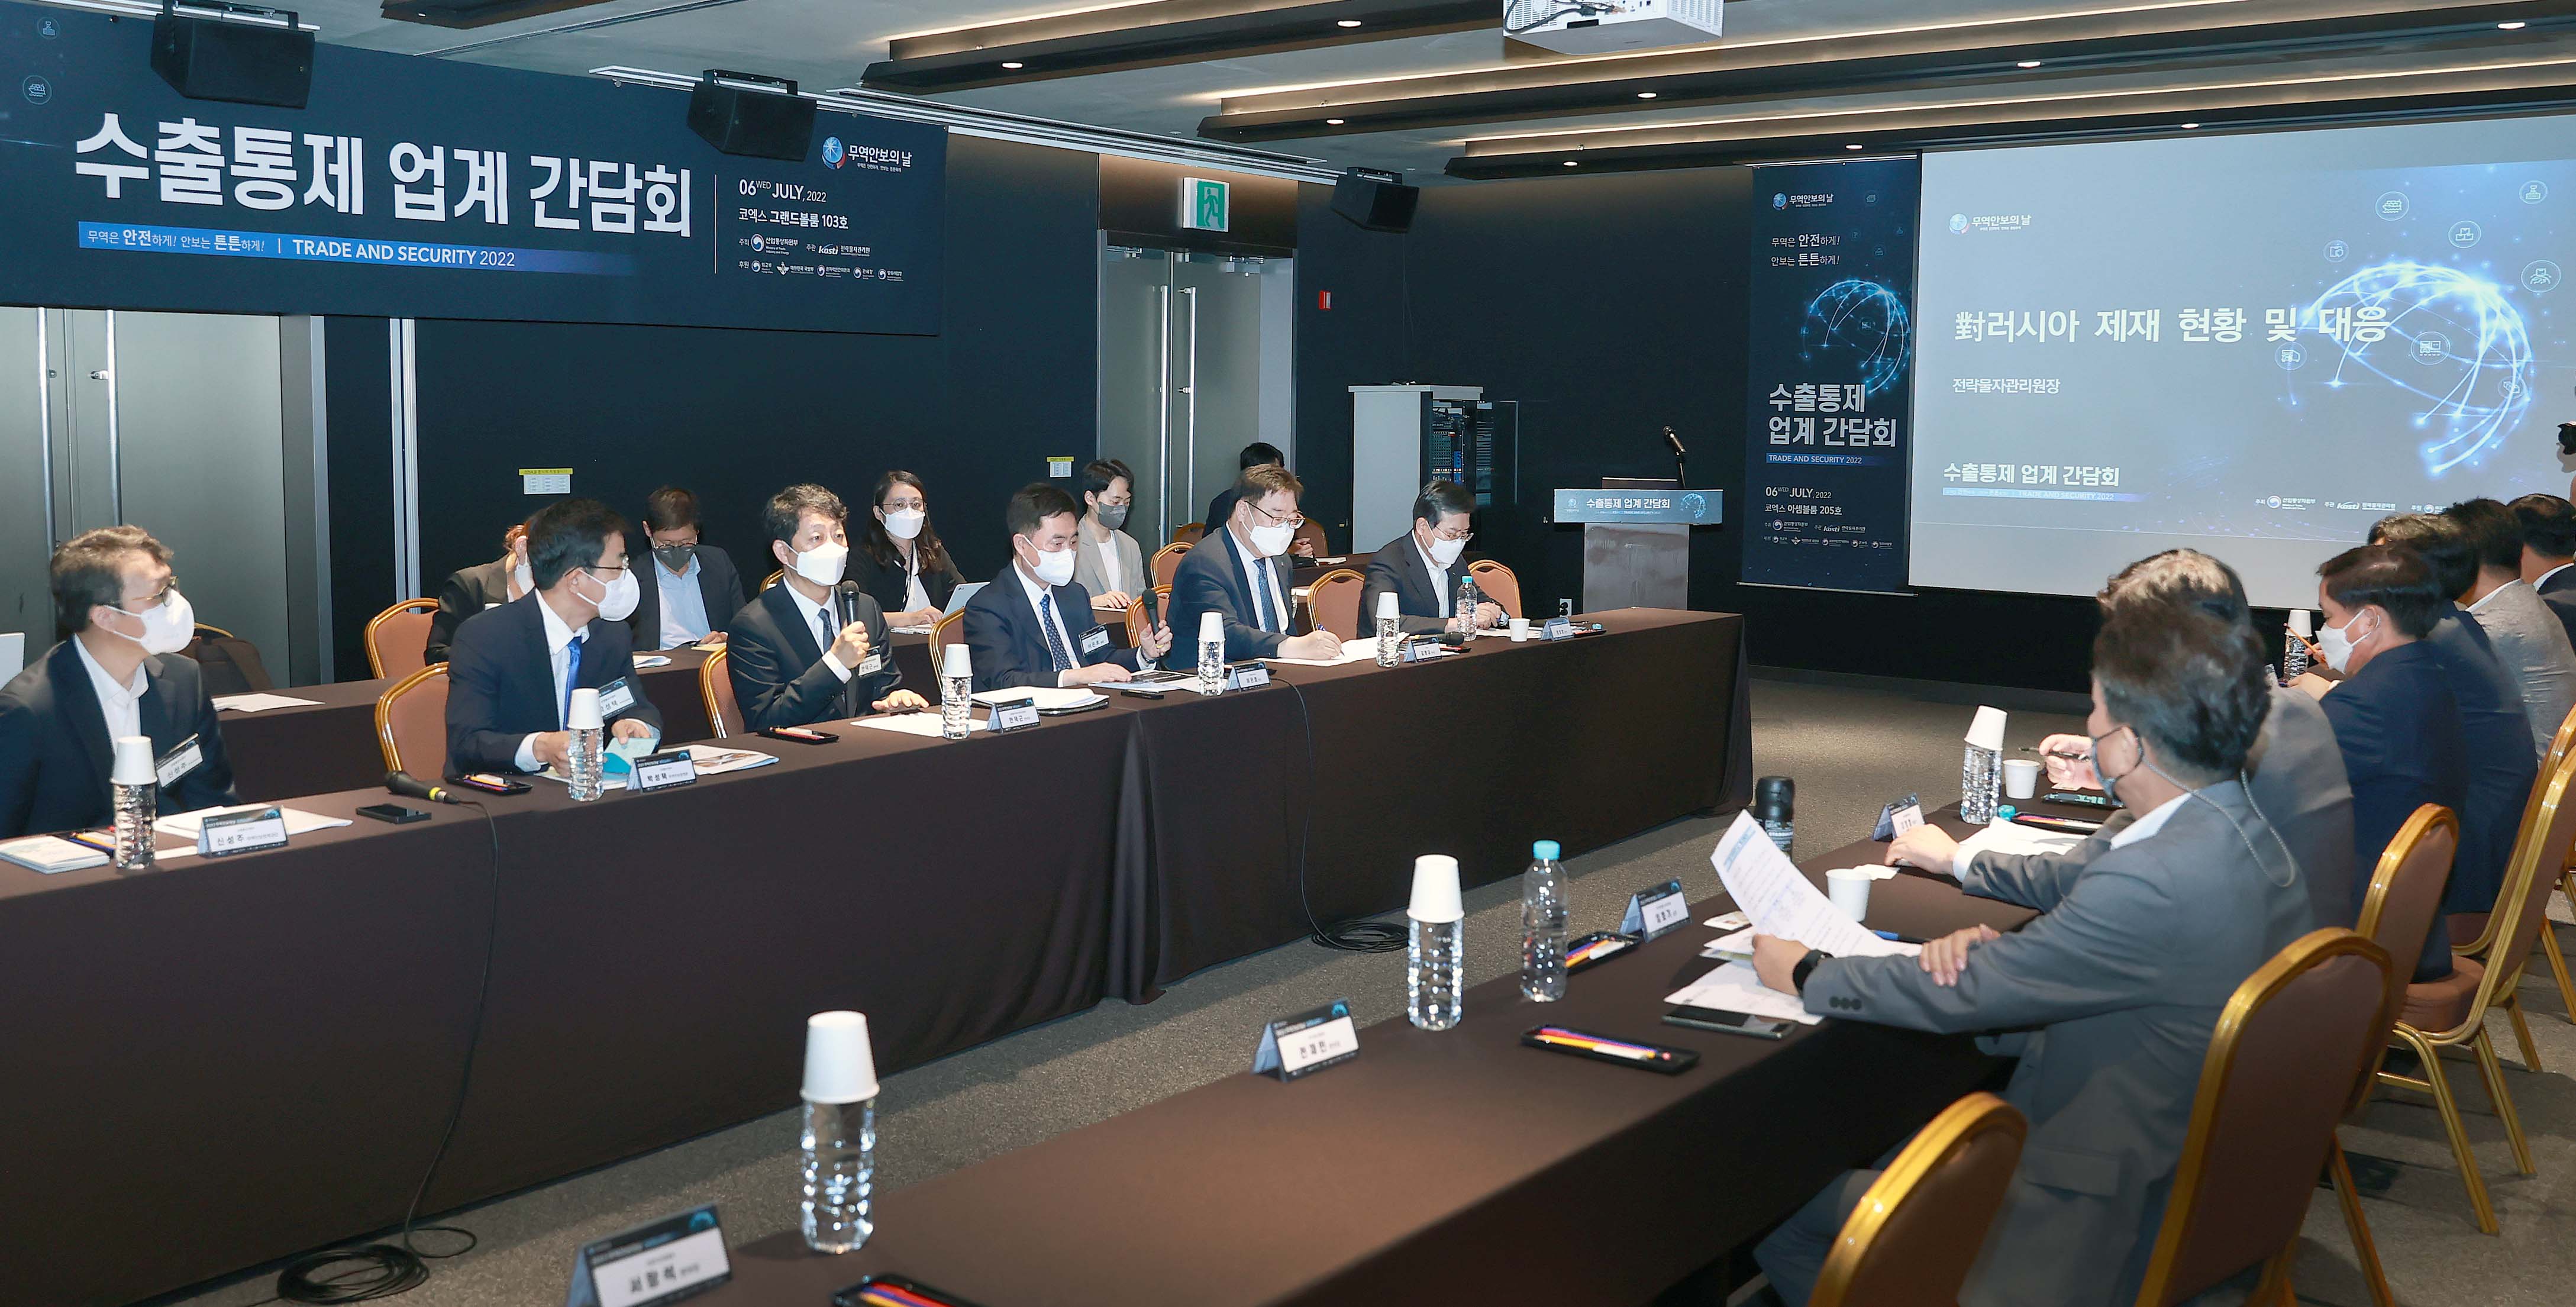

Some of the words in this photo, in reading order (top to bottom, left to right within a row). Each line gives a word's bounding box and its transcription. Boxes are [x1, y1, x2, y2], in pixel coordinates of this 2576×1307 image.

[848, 145, 900, 164] 무역안보의
[902, 151, 912, 167] 날
[76, 112, 364, 215] 수출통제
[389, 142, 509, 225] 업계
[530, 155, 691, 237] 간담회
[740, 179, 756, 196] 06
[756, 180, 771, 189] WED
[806, 191, 827, 202] 2022
[1789, 194, 1825, 204] 무역안보의
[1826, 193, 1834, 204] 날
[739, 208, 767, 222] 코엑스
[770, 211, 819, 228] 그랜드볼룸
[822, 214, 848, 229] 103호
[1971, 215, 2019, 227] 무역안보의
[2021, 214, 2032, 225] 날
[88, 230, 119, 244] 무역은
[122, 229, 177, 247] 안전하게!
[181, 236, 211, 249] 안보는
[214, 234, 265, 251] 튼튼하게!
[1771, 236, 1796, 248] 무역은
[1798, 234, 1841, 247] 안전하게!
[292, 239, 352, 257] TRADE
[355, 243, 394, 260] AND
[397, 246, 477, 265] SECURITY
[479, 251, 515, 267] 2022
[1771, 256, 1796, 266] 안보는
[1798, 253, 1840, 266] 튼튼하게!
[1955, 309, 2080, 343] 對러시아
[2094, 309, 2160, 343] 제재
[2178, 308, 2246, 343] 현황
[2265, 306, 2296, 342] 및
[2318, 306, 2389, 343] 대응
[1952, 378, 2060, 394] 전략물자관리원장
[1769, 383, 1865, 413] 수출통제
[1769, 416, 1815, 446] 업계
[1823, 418, 1897, 447] 간담회
[1811, 456, 1844, 464] SECURITY
[1944, 463, 2015, 483] 수출통제
[2021, 464, 2057, 485] 업계
[2063, 466, 2119, 486] 간담회
[1765, 486, 1778, 496] 06
[2061, 492, 2096, 500] SECURITY
[1586, 498, 1621, 509] 수출통제
[1624, 498, 1641, 509] 업계
[1644, 498, 1670, 509] 간담회
[1765, 504, 1786, 513] 코엑스
[1787, 505, 1818, 515] 아셈볼룸
[1819, 506, 1842, 515] 205호
